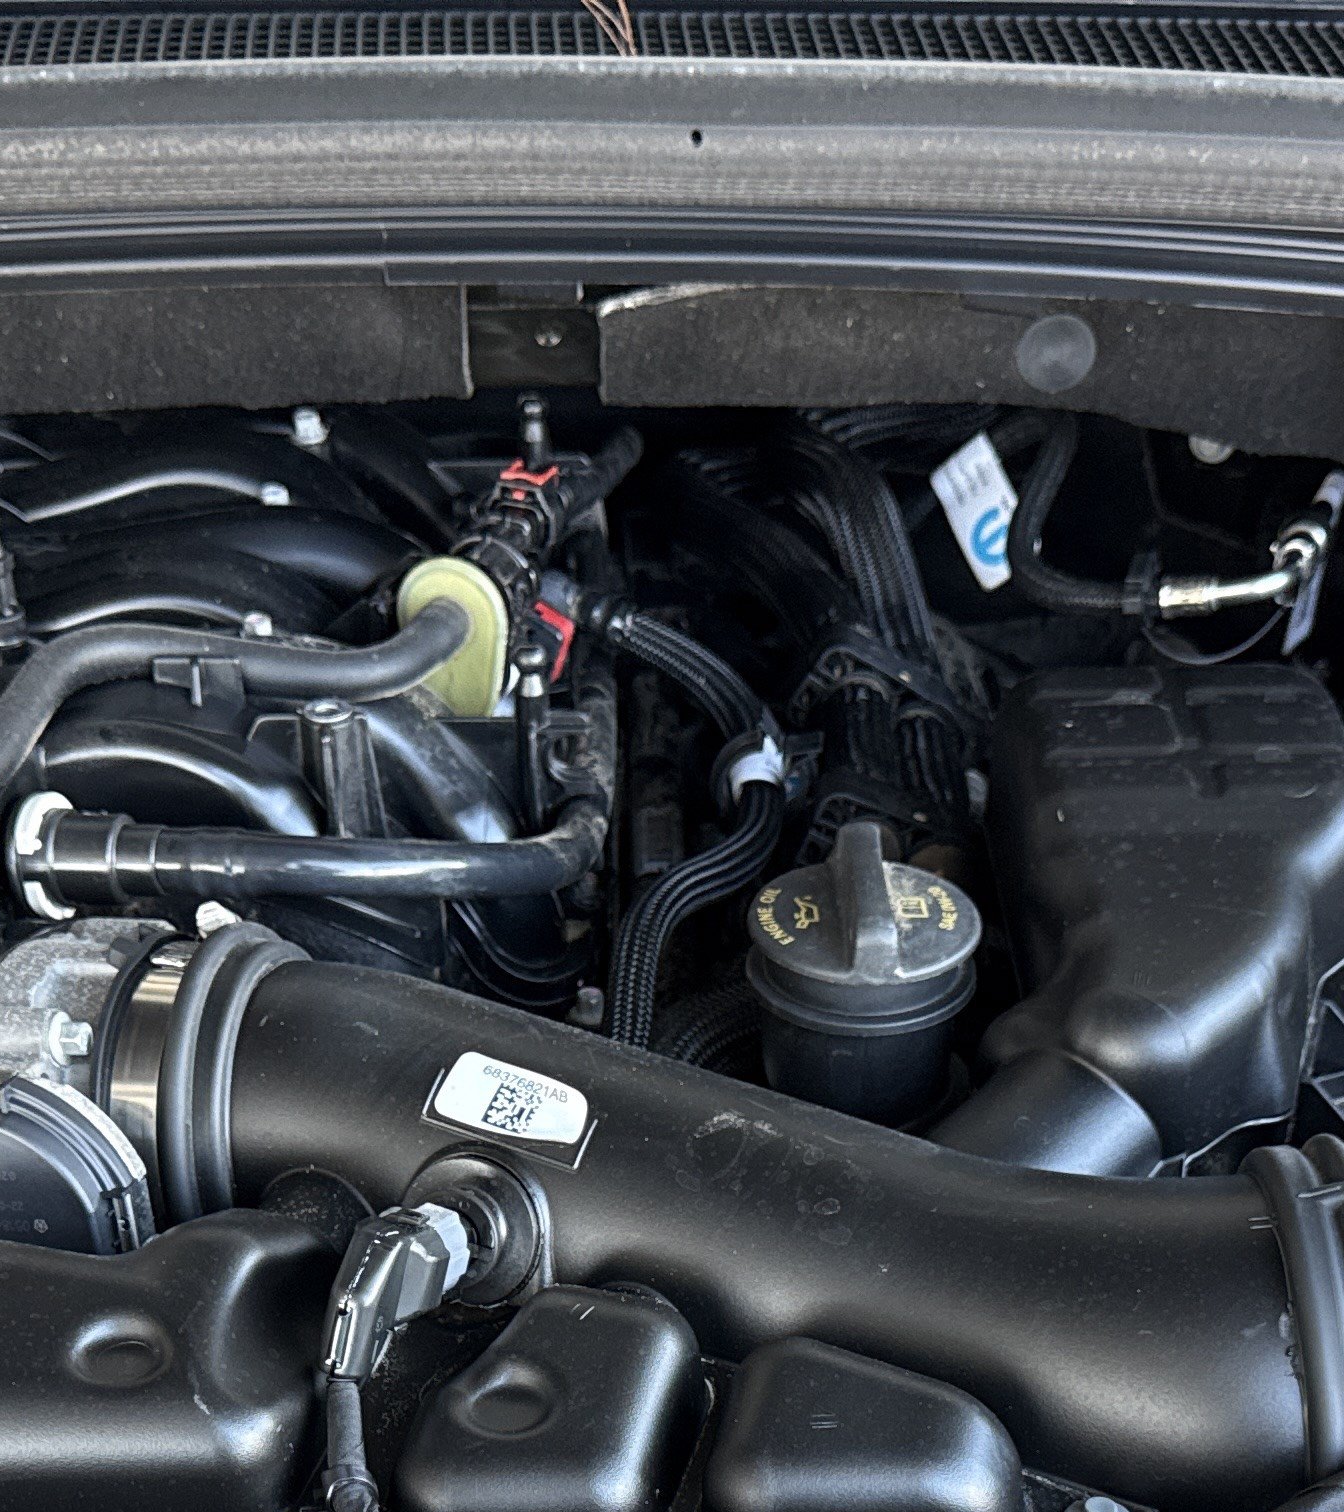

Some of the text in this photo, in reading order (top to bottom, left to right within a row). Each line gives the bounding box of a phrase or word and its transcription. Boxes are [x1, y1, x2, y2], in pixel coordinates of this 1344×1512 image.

[757, 887, 796, 946] ENGINE OIL
[938, 911, 958, 931] SAE
[482, 1065, 568, 1103] 68376821AB
